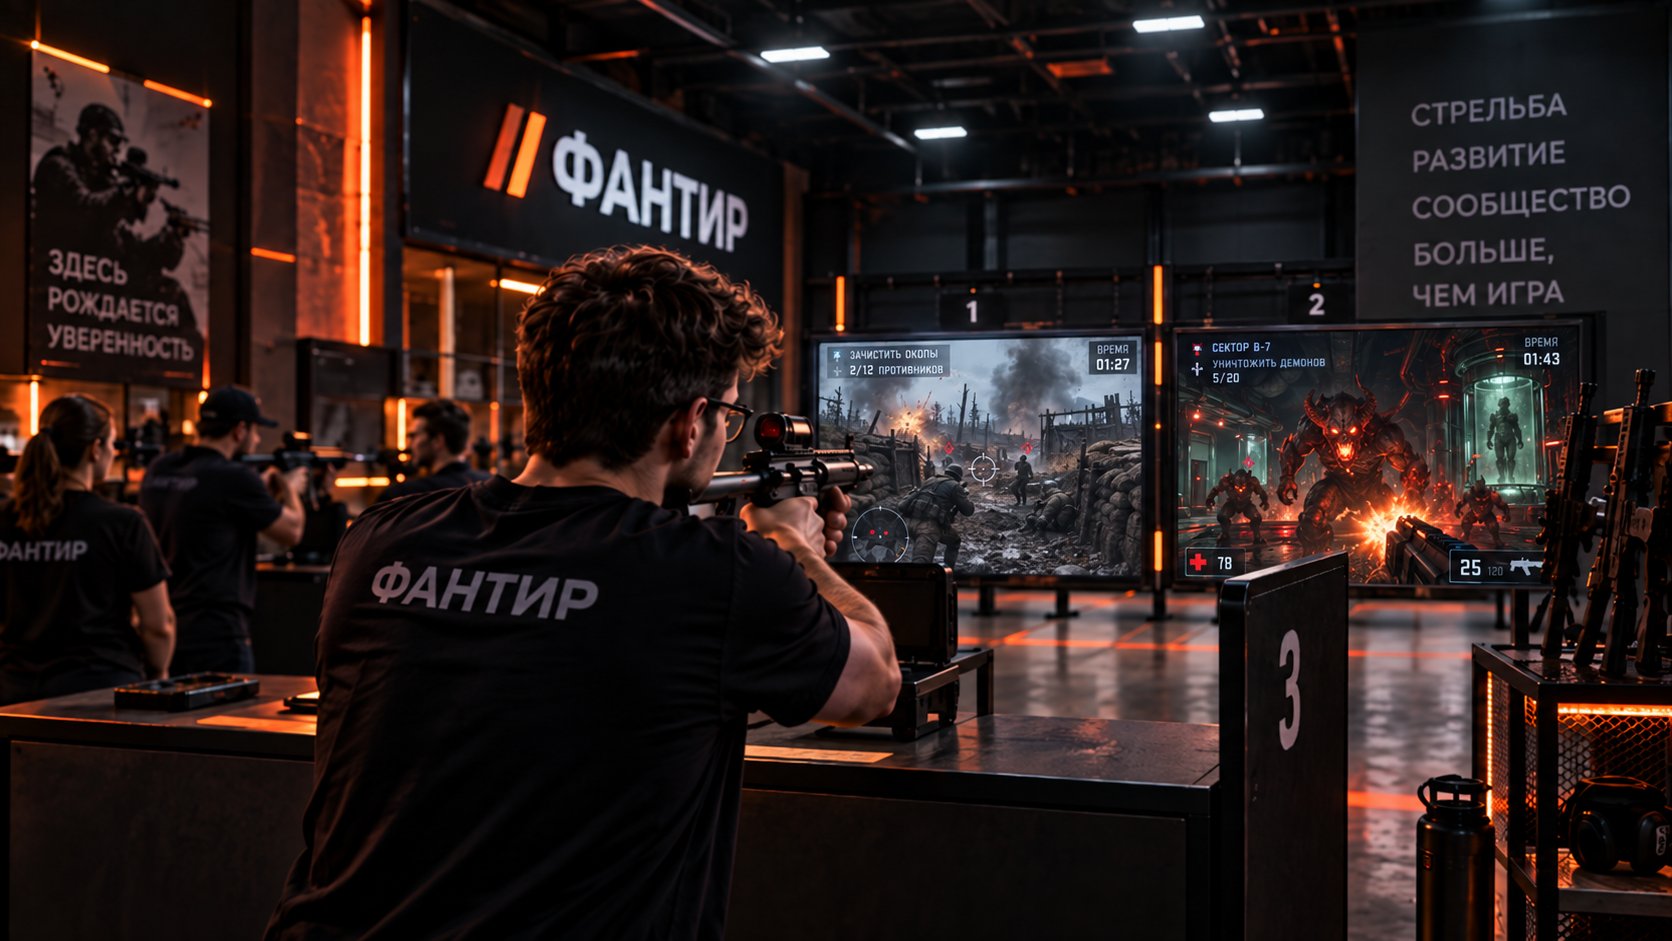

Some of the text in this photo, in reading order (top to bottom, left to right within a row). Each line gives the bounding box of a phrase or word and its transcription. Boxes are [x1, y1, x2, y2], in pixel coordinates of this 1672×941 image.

[1411, 92, 1568, 127] СТРЕЛЬБА
[1412, 139, 1567, 173] РАЗВИТИЕ
[551, 129, 749, 253] ФАНТИР
[1411, 184, 1632, 220] СООБЩЕСТВО
[1413, 237, 1555, 266] БОЛЬШЕ,
[48, 248, 128, 286] ЗДЕСЬ
[1308, 293, 1326, 317] 2
[1412, 279, 1565, 308] ЧЕМ ИГРА
[48, 286, 180, 328] РОЖДАЕТСЯ
[965, 300, 978, 324] 1
[46, 323, 194, 362] УВЕРЕННОСТЬ
[1096, 344, 1130, 356] ВРЕМЯ
[1212, 342, 1250, 353] СЕКТОР
[1523, 336, 1560, 348] ВРЕМЯ
[849, 349, 939, 360] ЗАЧИСТИТЬ ОКОПЫ
[1095, 357, 1131, 372] 01:27
[1212, 358, 1326, 369] УНИЧТОЖИТЬ ДЕМОНОВ
[1523, 351, 1561, 367] 01:43
[849, 364, 944, 377] 2/12 ПРОТИВНИКОВ
[1212, 372, 1240, 384] 5/20
[1217, 555, 1233, 571] 78
[1460, 559, 1481, 576] 25
[1487, 566, 1504, 576] 120
[370, 560, 600, 621] ФАНТИР
[1278, 628, 1302, 752] 3
